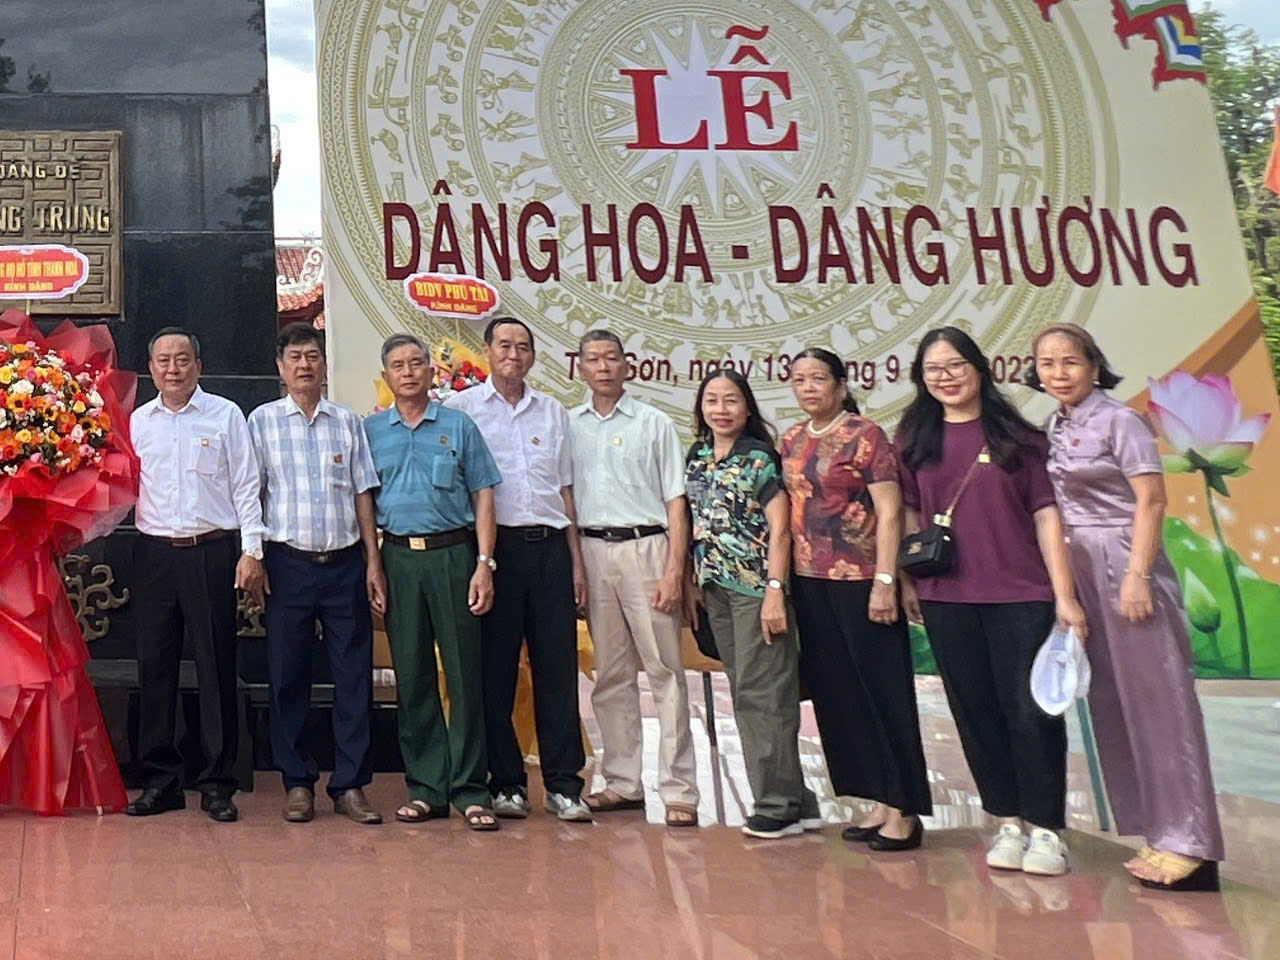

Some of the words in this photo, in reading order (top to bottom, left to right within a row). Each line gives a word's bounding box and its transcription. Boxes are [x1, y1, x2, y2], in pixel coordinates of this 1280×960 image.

[620, 25, 799, 151] LỄ
[35, 206, 110, 233] TRUNG
[383, 180, 560, 284] DÂNG
[582, 202, 714, 284] HOA
[732, 245, 749, 259] -
[769, 183, 950, 287] DÂNG
[967, 196, 1199, 288] HƯƠNG
[415, 281, 442, 298] BIDV
[764, 354, 792, 382] 13
[886, 355, 900, 383] 9
